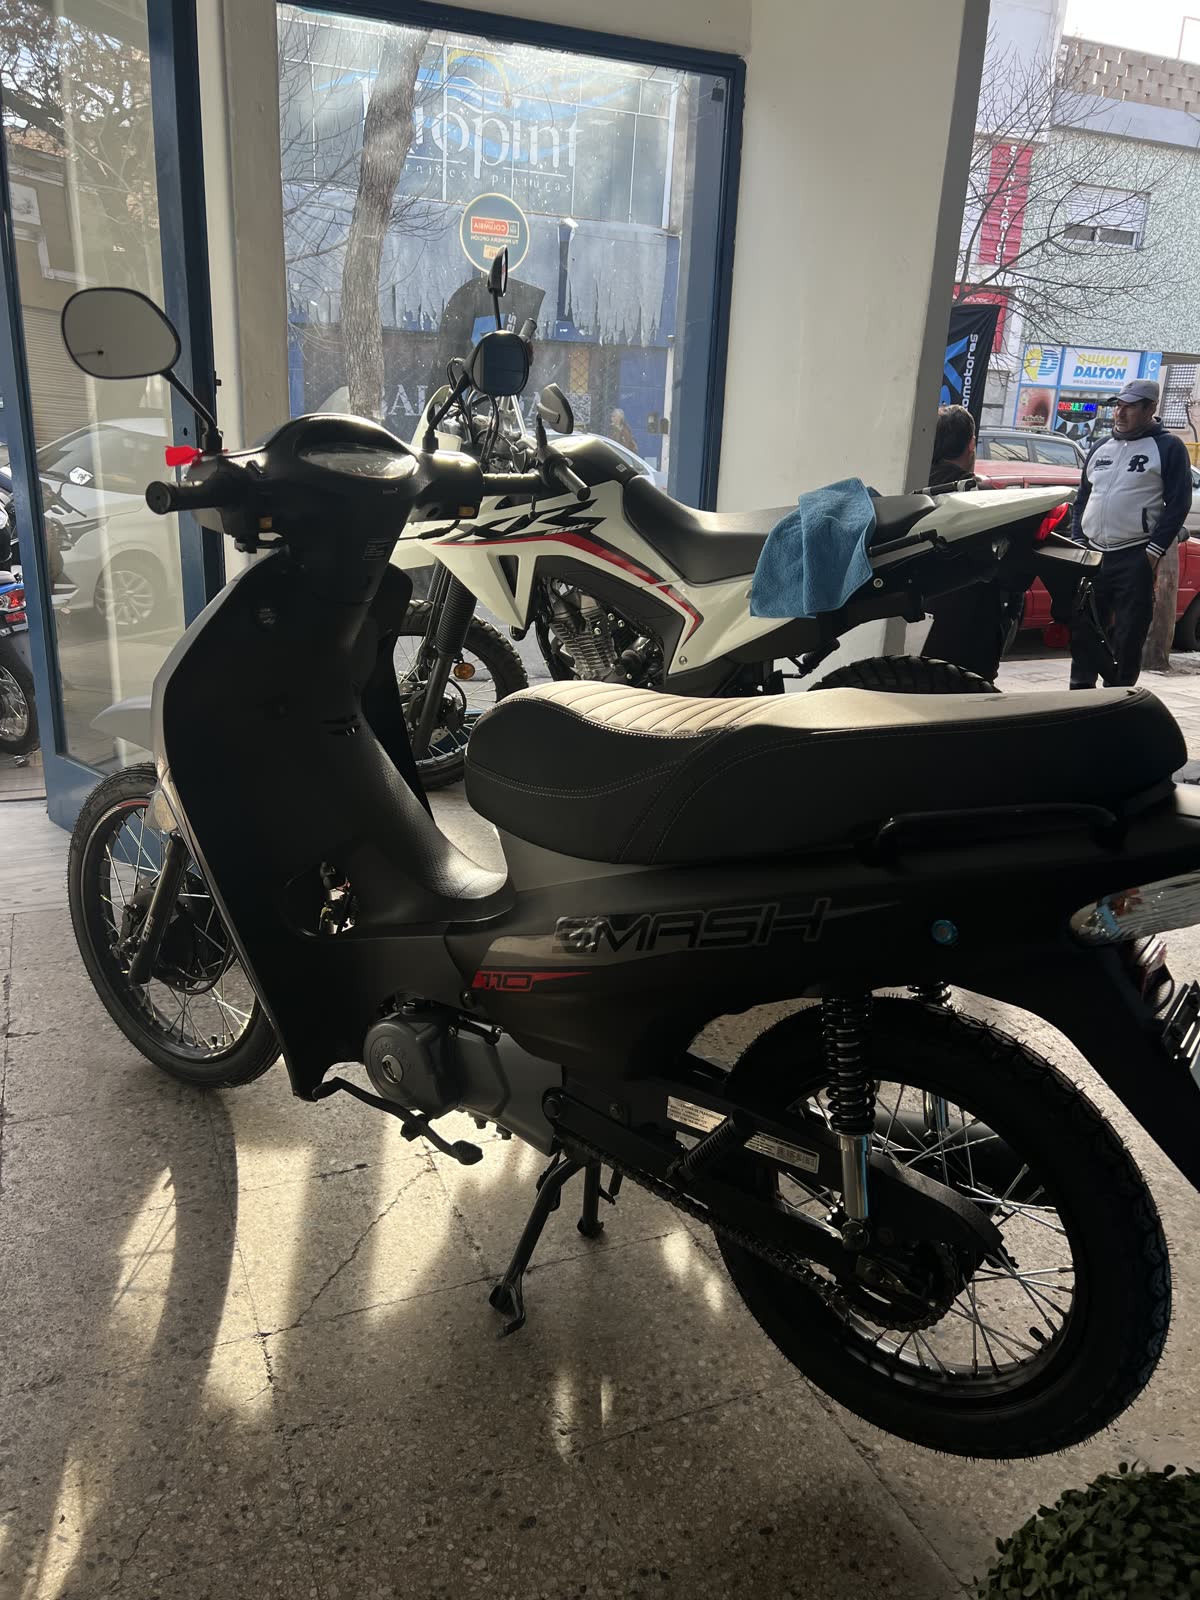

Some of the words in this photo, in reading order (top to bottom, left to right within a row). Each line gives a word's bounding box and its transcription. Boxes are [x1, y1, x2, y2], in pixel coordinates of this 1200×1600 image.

[962, 334, 978, 411] omotoras
[1073, 366, 1127, 380] DALTON
[1127, 454, 1150, 473] R
[553, 897, 832, 953] SMASH
[481, 972, 534, 992] 110
